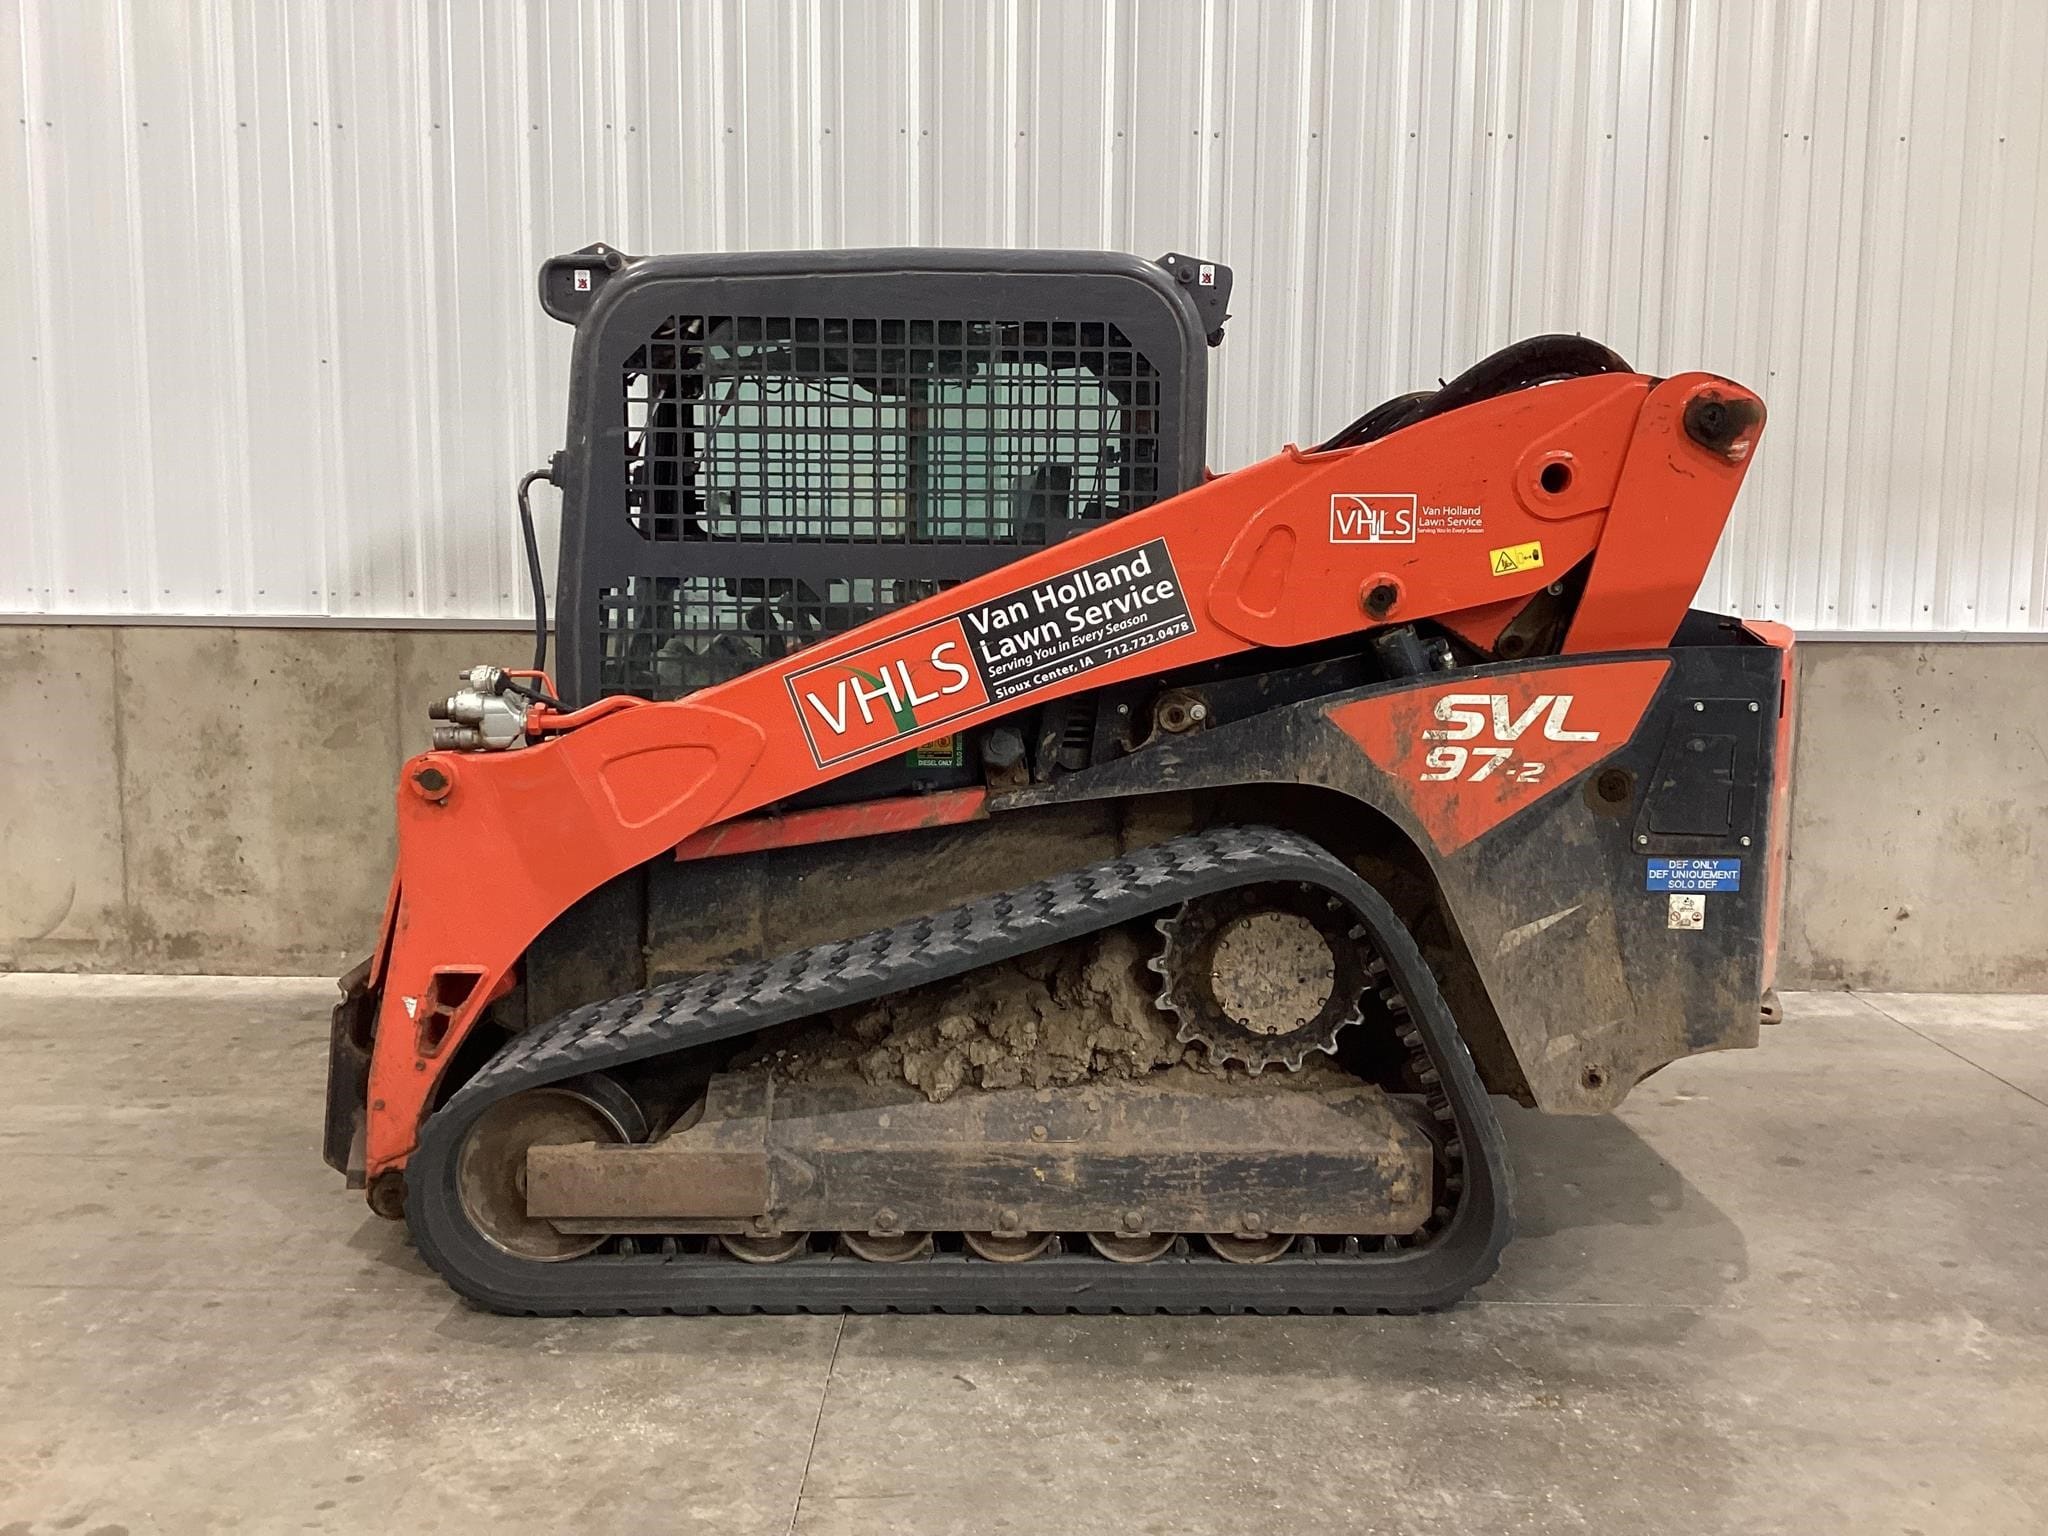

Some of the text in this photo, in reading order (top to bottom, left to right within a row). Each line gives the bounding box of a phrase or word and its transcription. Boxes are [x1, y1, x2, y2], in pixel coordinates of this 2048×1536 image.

[1336, 510, 1411, 535] VHLS
[1419, 517, 1483, 526] Lawn Service
[1422, 506, 1481, 515] Van Holland
[968, 550, 1152, 635] Van Holland
[979, 579, 1175, 664] Lawn Service
[988, 612, 1148, 678] Serving You in Every Season
[995, 621, 1190, 699] Sioux Center, IA 712.722.0478
[806, 642, 970, 734] VHLS
[1422, 694, 1600, 742] SVL
[1419, 746, 1546, 782] 97-2
[1649, 870, 1738, 879] DEF UNIQUEMENT
[1669, 860, 1719, 869] DEF ONLY
[1668, 880, 1718, 888] SOLO DEF
